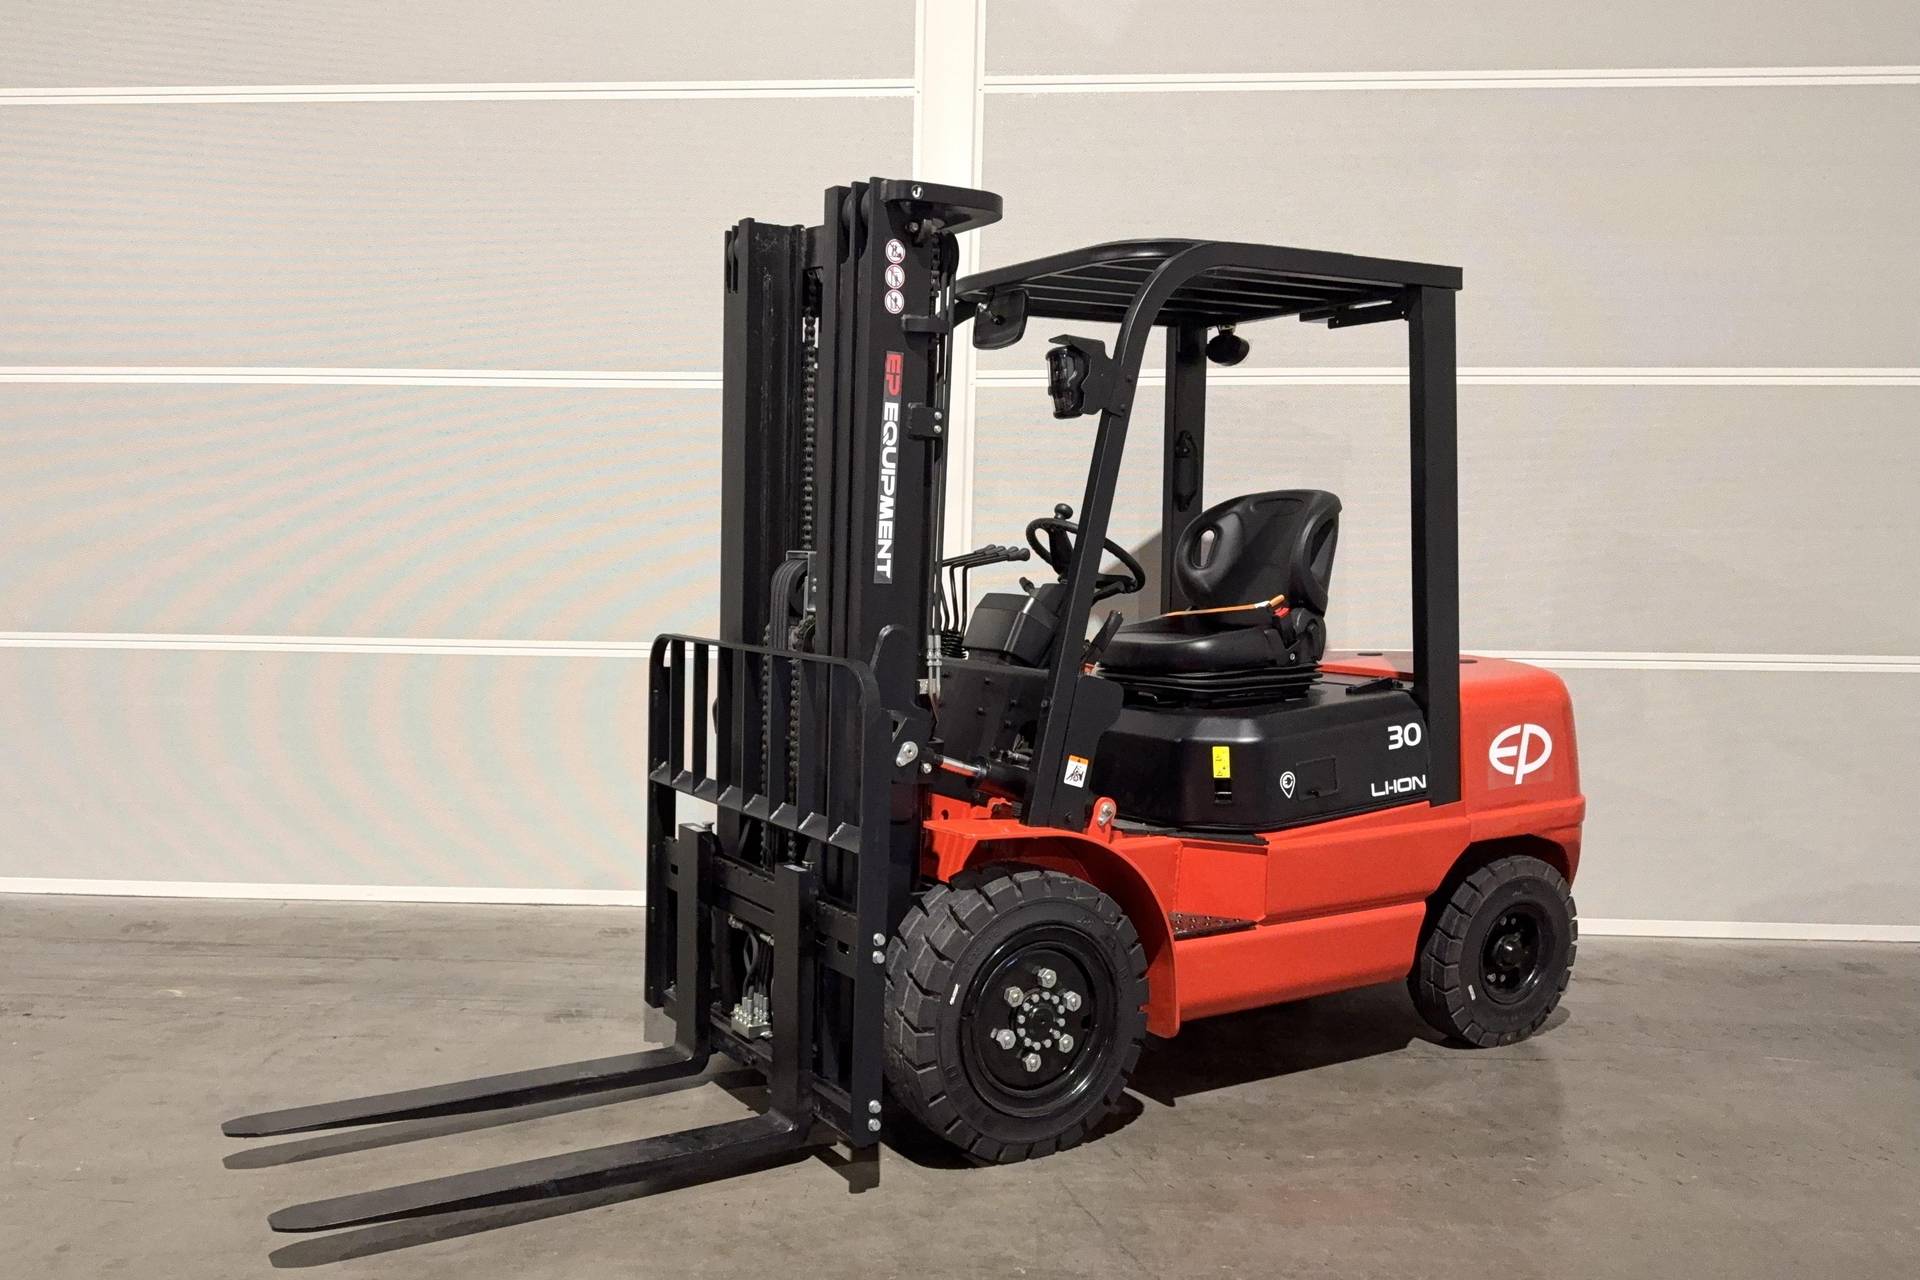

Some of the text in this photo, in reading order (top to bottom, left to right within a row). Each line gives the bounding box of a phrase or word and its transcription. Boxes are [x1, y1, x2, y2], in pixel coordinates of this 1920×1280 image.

[876, 353, 903, 579] EP EQUIPMENT
[1387, 722, 1422, 751] 30
[1488, 723, 1553, 785] EP
